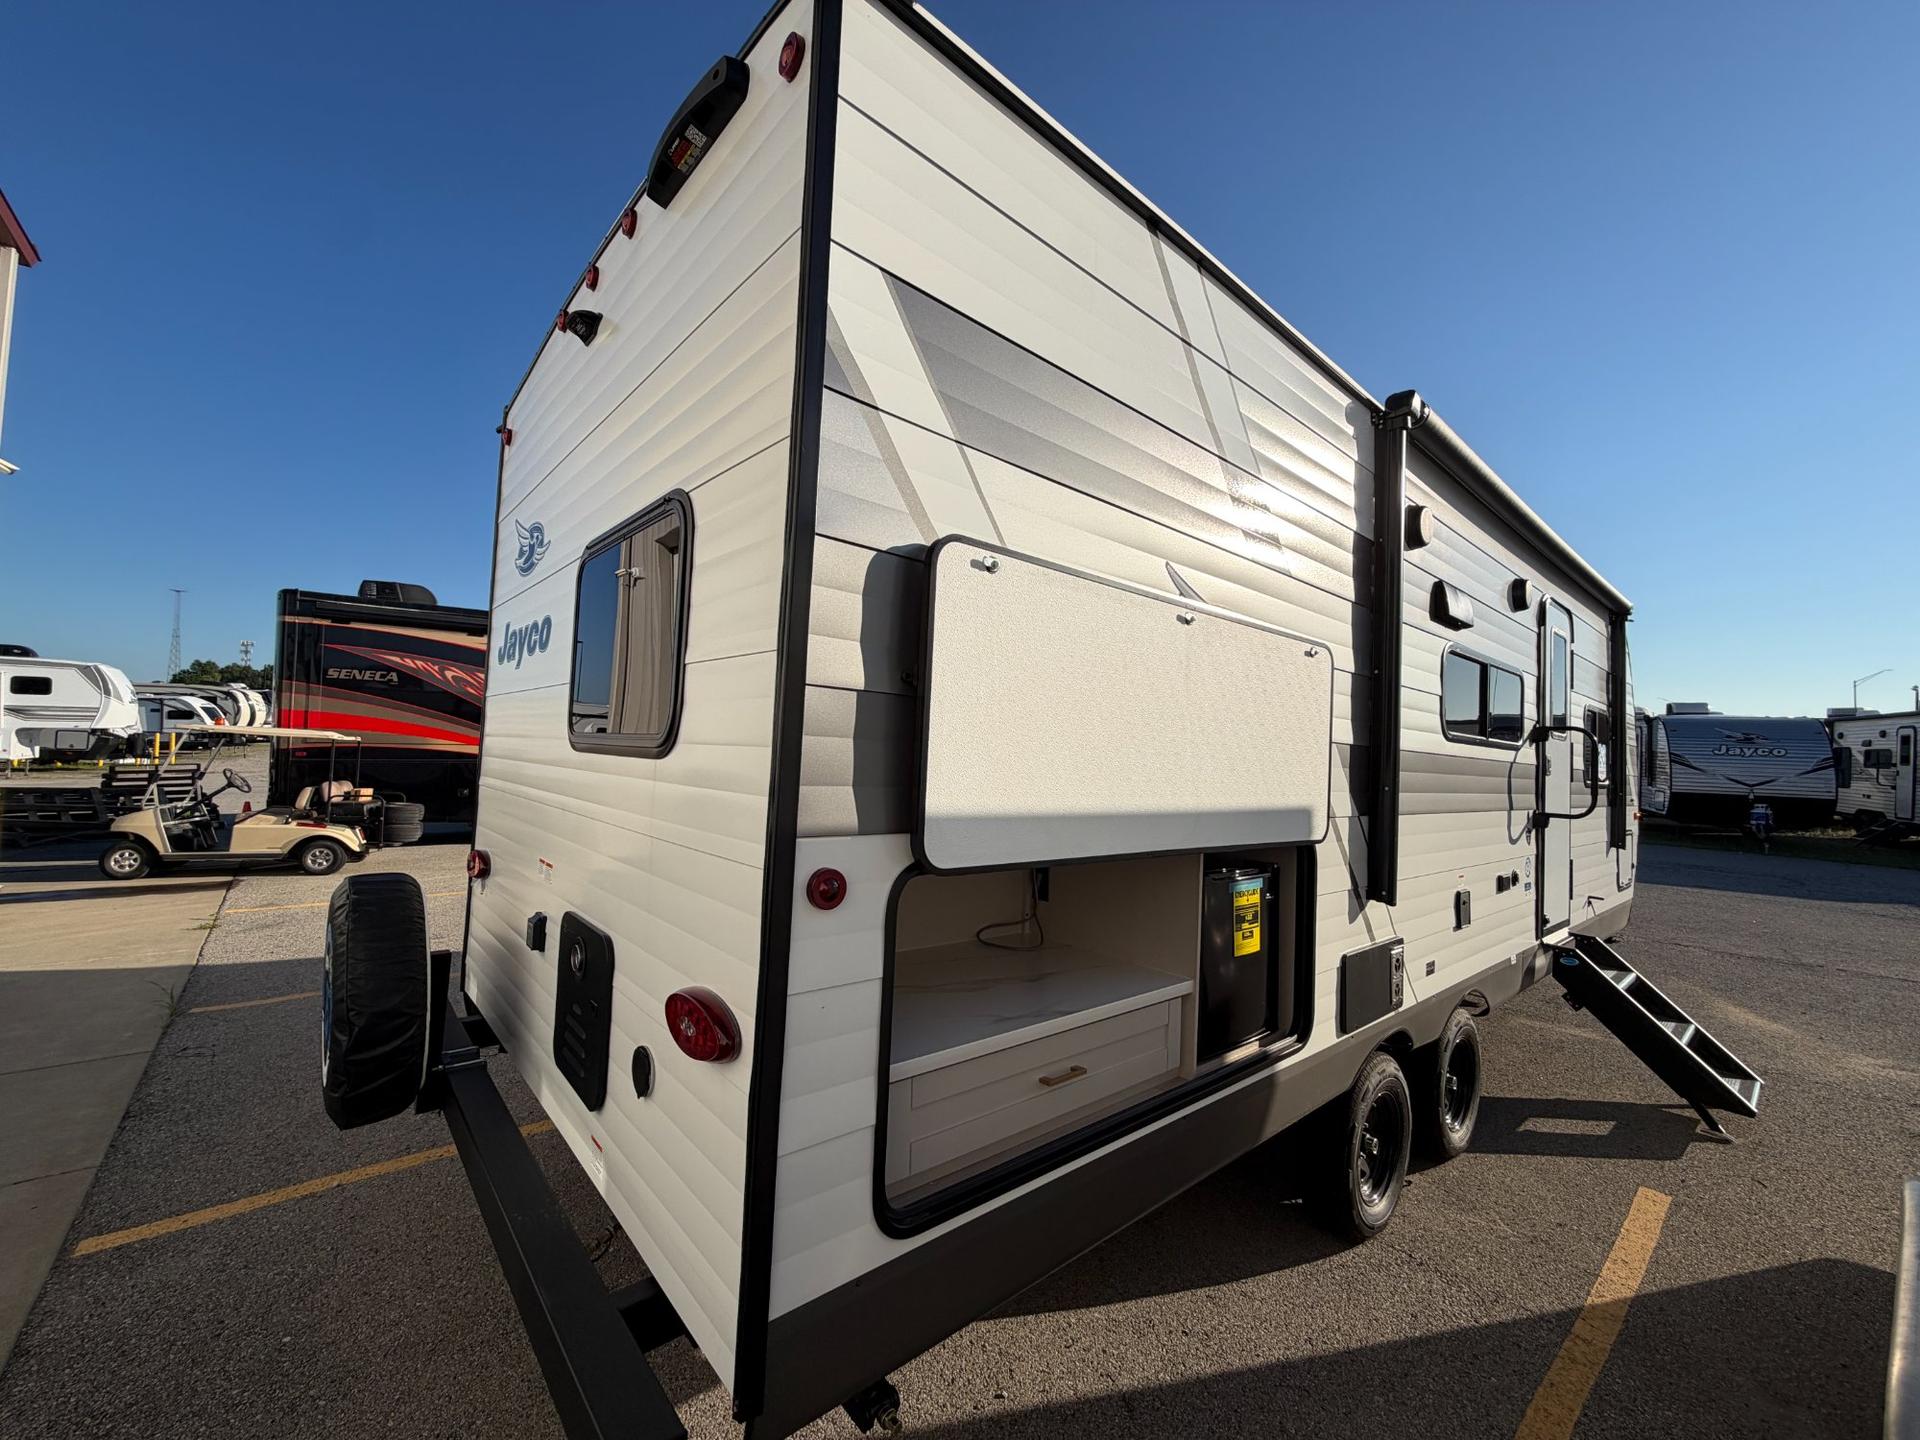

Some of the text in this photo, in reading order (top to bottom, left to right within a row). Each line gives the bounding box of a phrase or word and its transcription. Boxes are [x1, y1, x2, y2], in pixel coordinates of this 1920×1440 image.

[497, 614, 552, 670] Jayco
[326, 668, 399, 682] SENECA
[1712, 744, 1788, 758] Jayco
